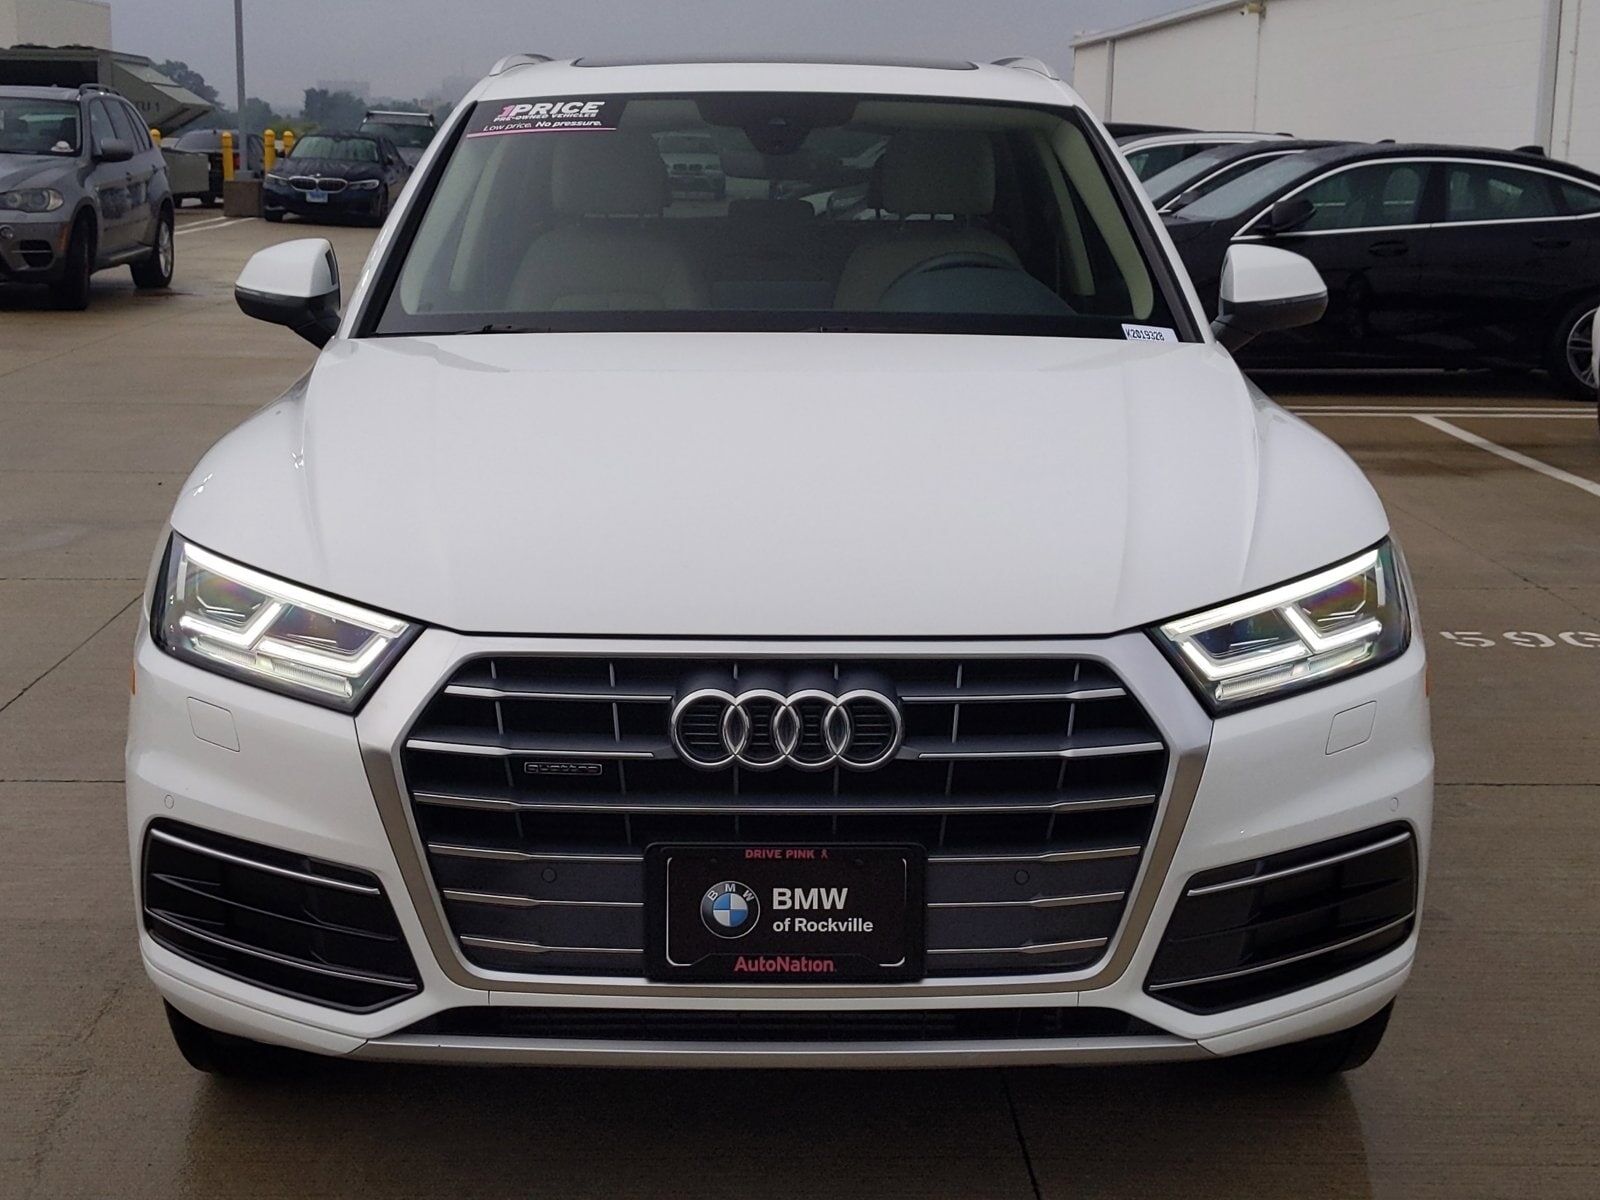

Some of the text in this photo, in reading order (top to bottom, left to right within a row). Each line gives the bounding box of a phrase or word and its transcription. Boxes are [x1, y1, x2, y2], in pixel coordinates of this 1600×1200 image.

[493, 113, 549, 122] PRE-OWNED
[483, 123, 505, 132] Low
[535, 120, 552, 128] No
[552, 120, 603, 128] pressure.
[745, 849, 815, 859] DRIVE PINK
[707, 883, 755, 902] BMW
[772, 887, 848, 910] BMW
[772, 917, 874, 932] of Rockville
[733, 956, 835, 973] AutoNation
